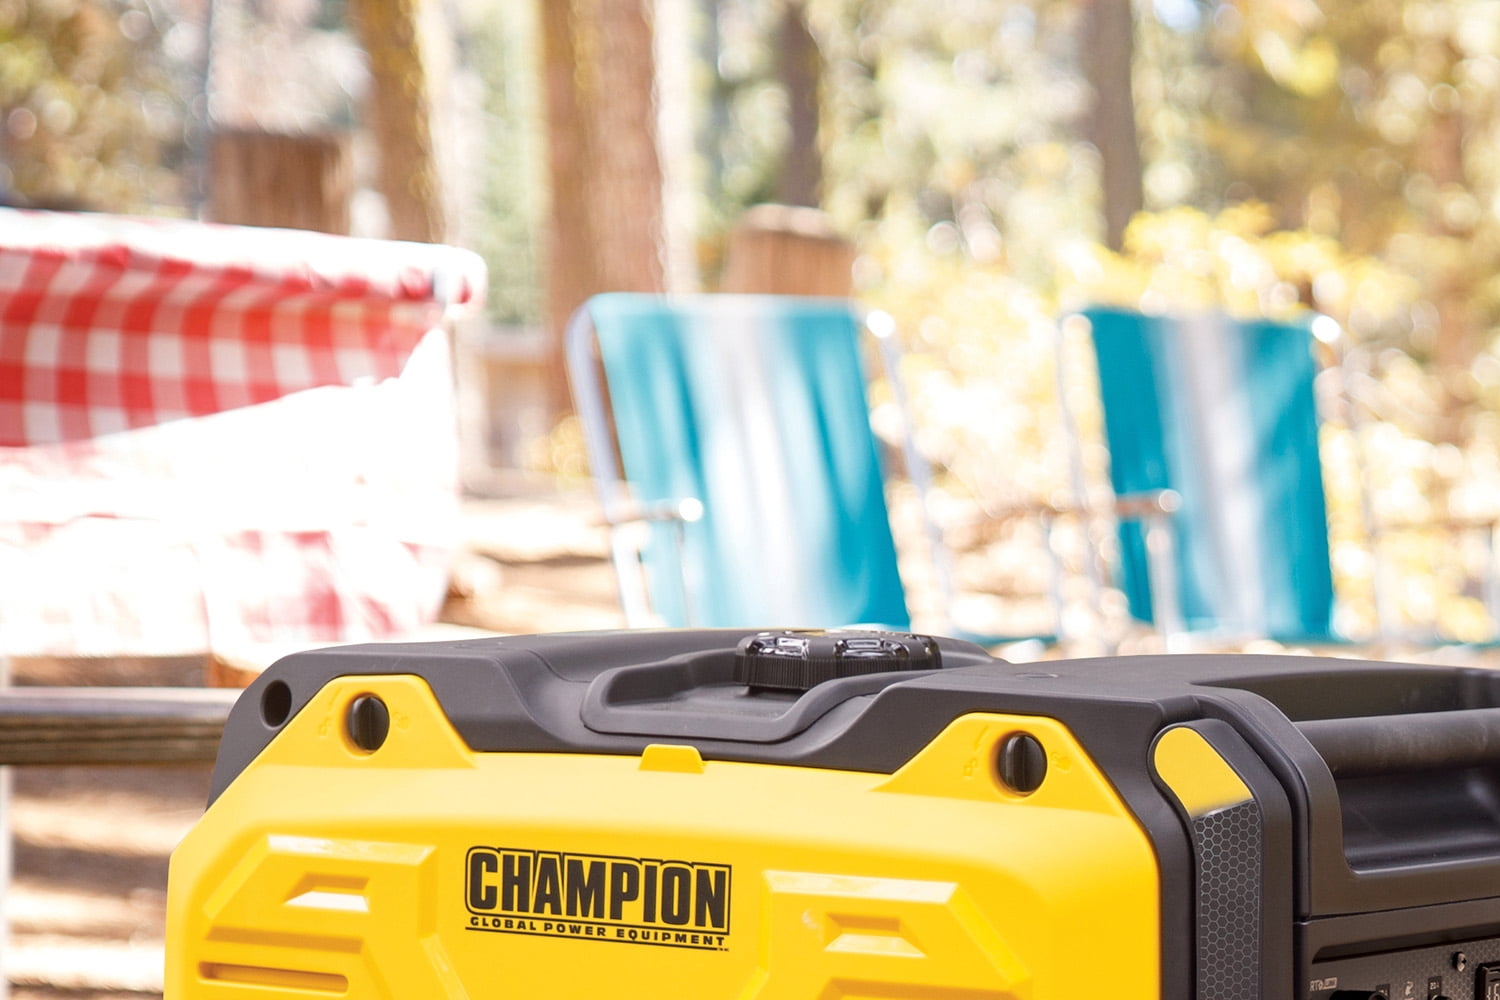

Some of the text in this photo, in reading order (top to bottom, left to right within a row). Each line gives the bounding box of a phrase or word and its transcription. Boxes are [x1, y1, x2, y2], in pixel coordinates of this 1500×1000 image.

[470, 852, 726, 928] CHAMPION
[470, 917, 725, 946] GLOBAL POWER EQUIPMENT
